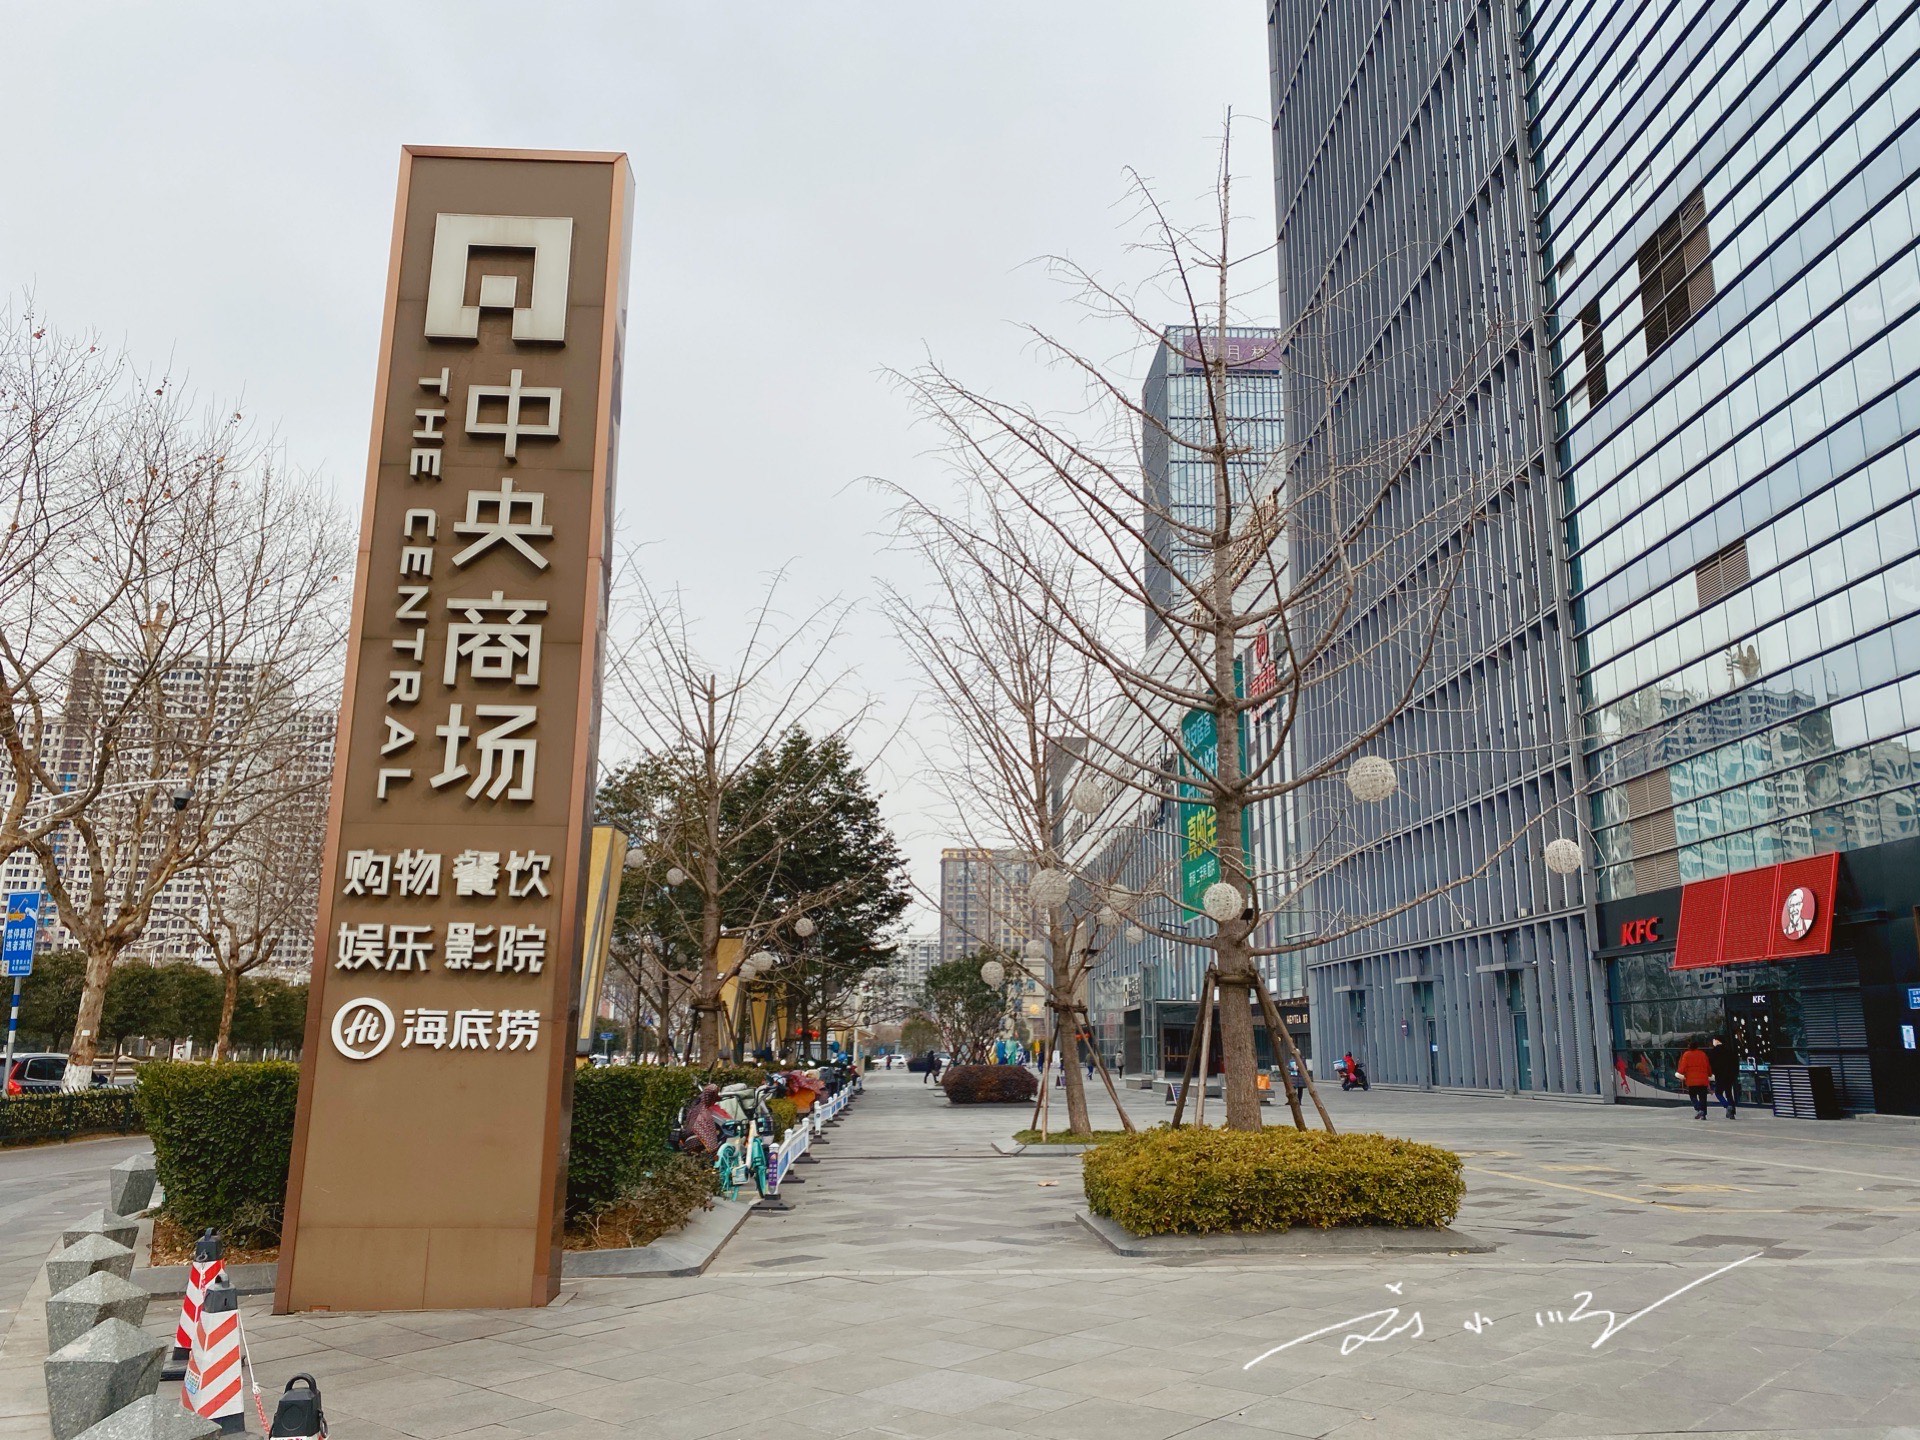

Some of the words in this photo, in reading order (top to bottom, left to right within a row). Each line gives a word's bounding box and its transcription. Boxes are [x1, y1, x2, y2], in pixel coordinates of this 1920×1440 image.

[409, 367, 449, 481] THE
[429, 369, 562, 801] 中央商场
[376, 508, 438, 800] CENTRAL
[343, 849, 441, 896] 购物
[452, 849, 551, 897] 餐饮
[335, 922, 434, 971] 娱乐
[444, 922, 547, 973] 影院
[1621, 917, 1658, 946] KFC
[1752, 995, 1766, 1003] KFC
[401, 1008, 540, 1051] 海底捞
